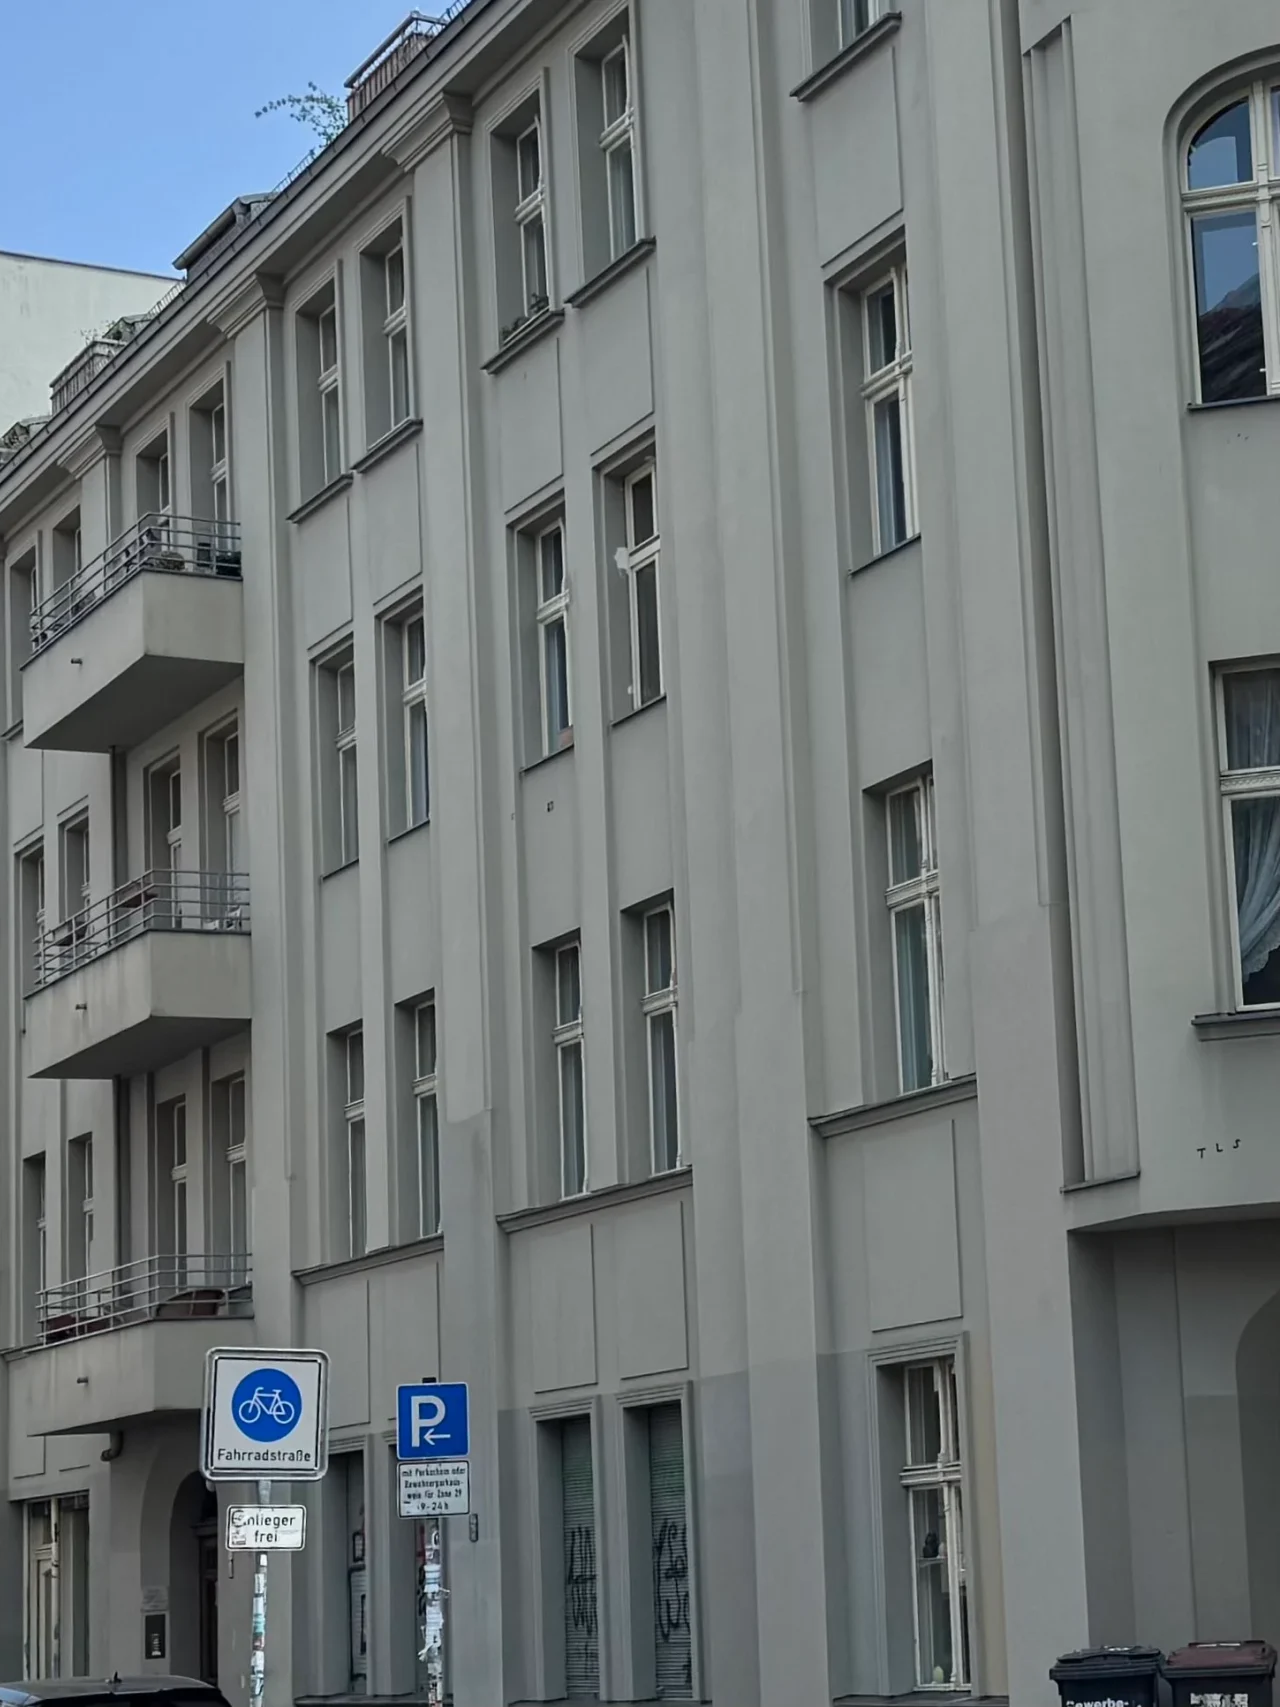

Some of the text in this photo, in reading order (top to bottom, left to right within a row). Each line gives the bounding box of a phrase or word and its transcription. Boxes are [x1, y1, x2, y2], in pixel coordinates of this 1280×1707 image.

[411, 1395, 446, 1447] P
[217, 1448, 311, 1462] Fahrradstraße
[254, 1530, 278, 1543] frei
